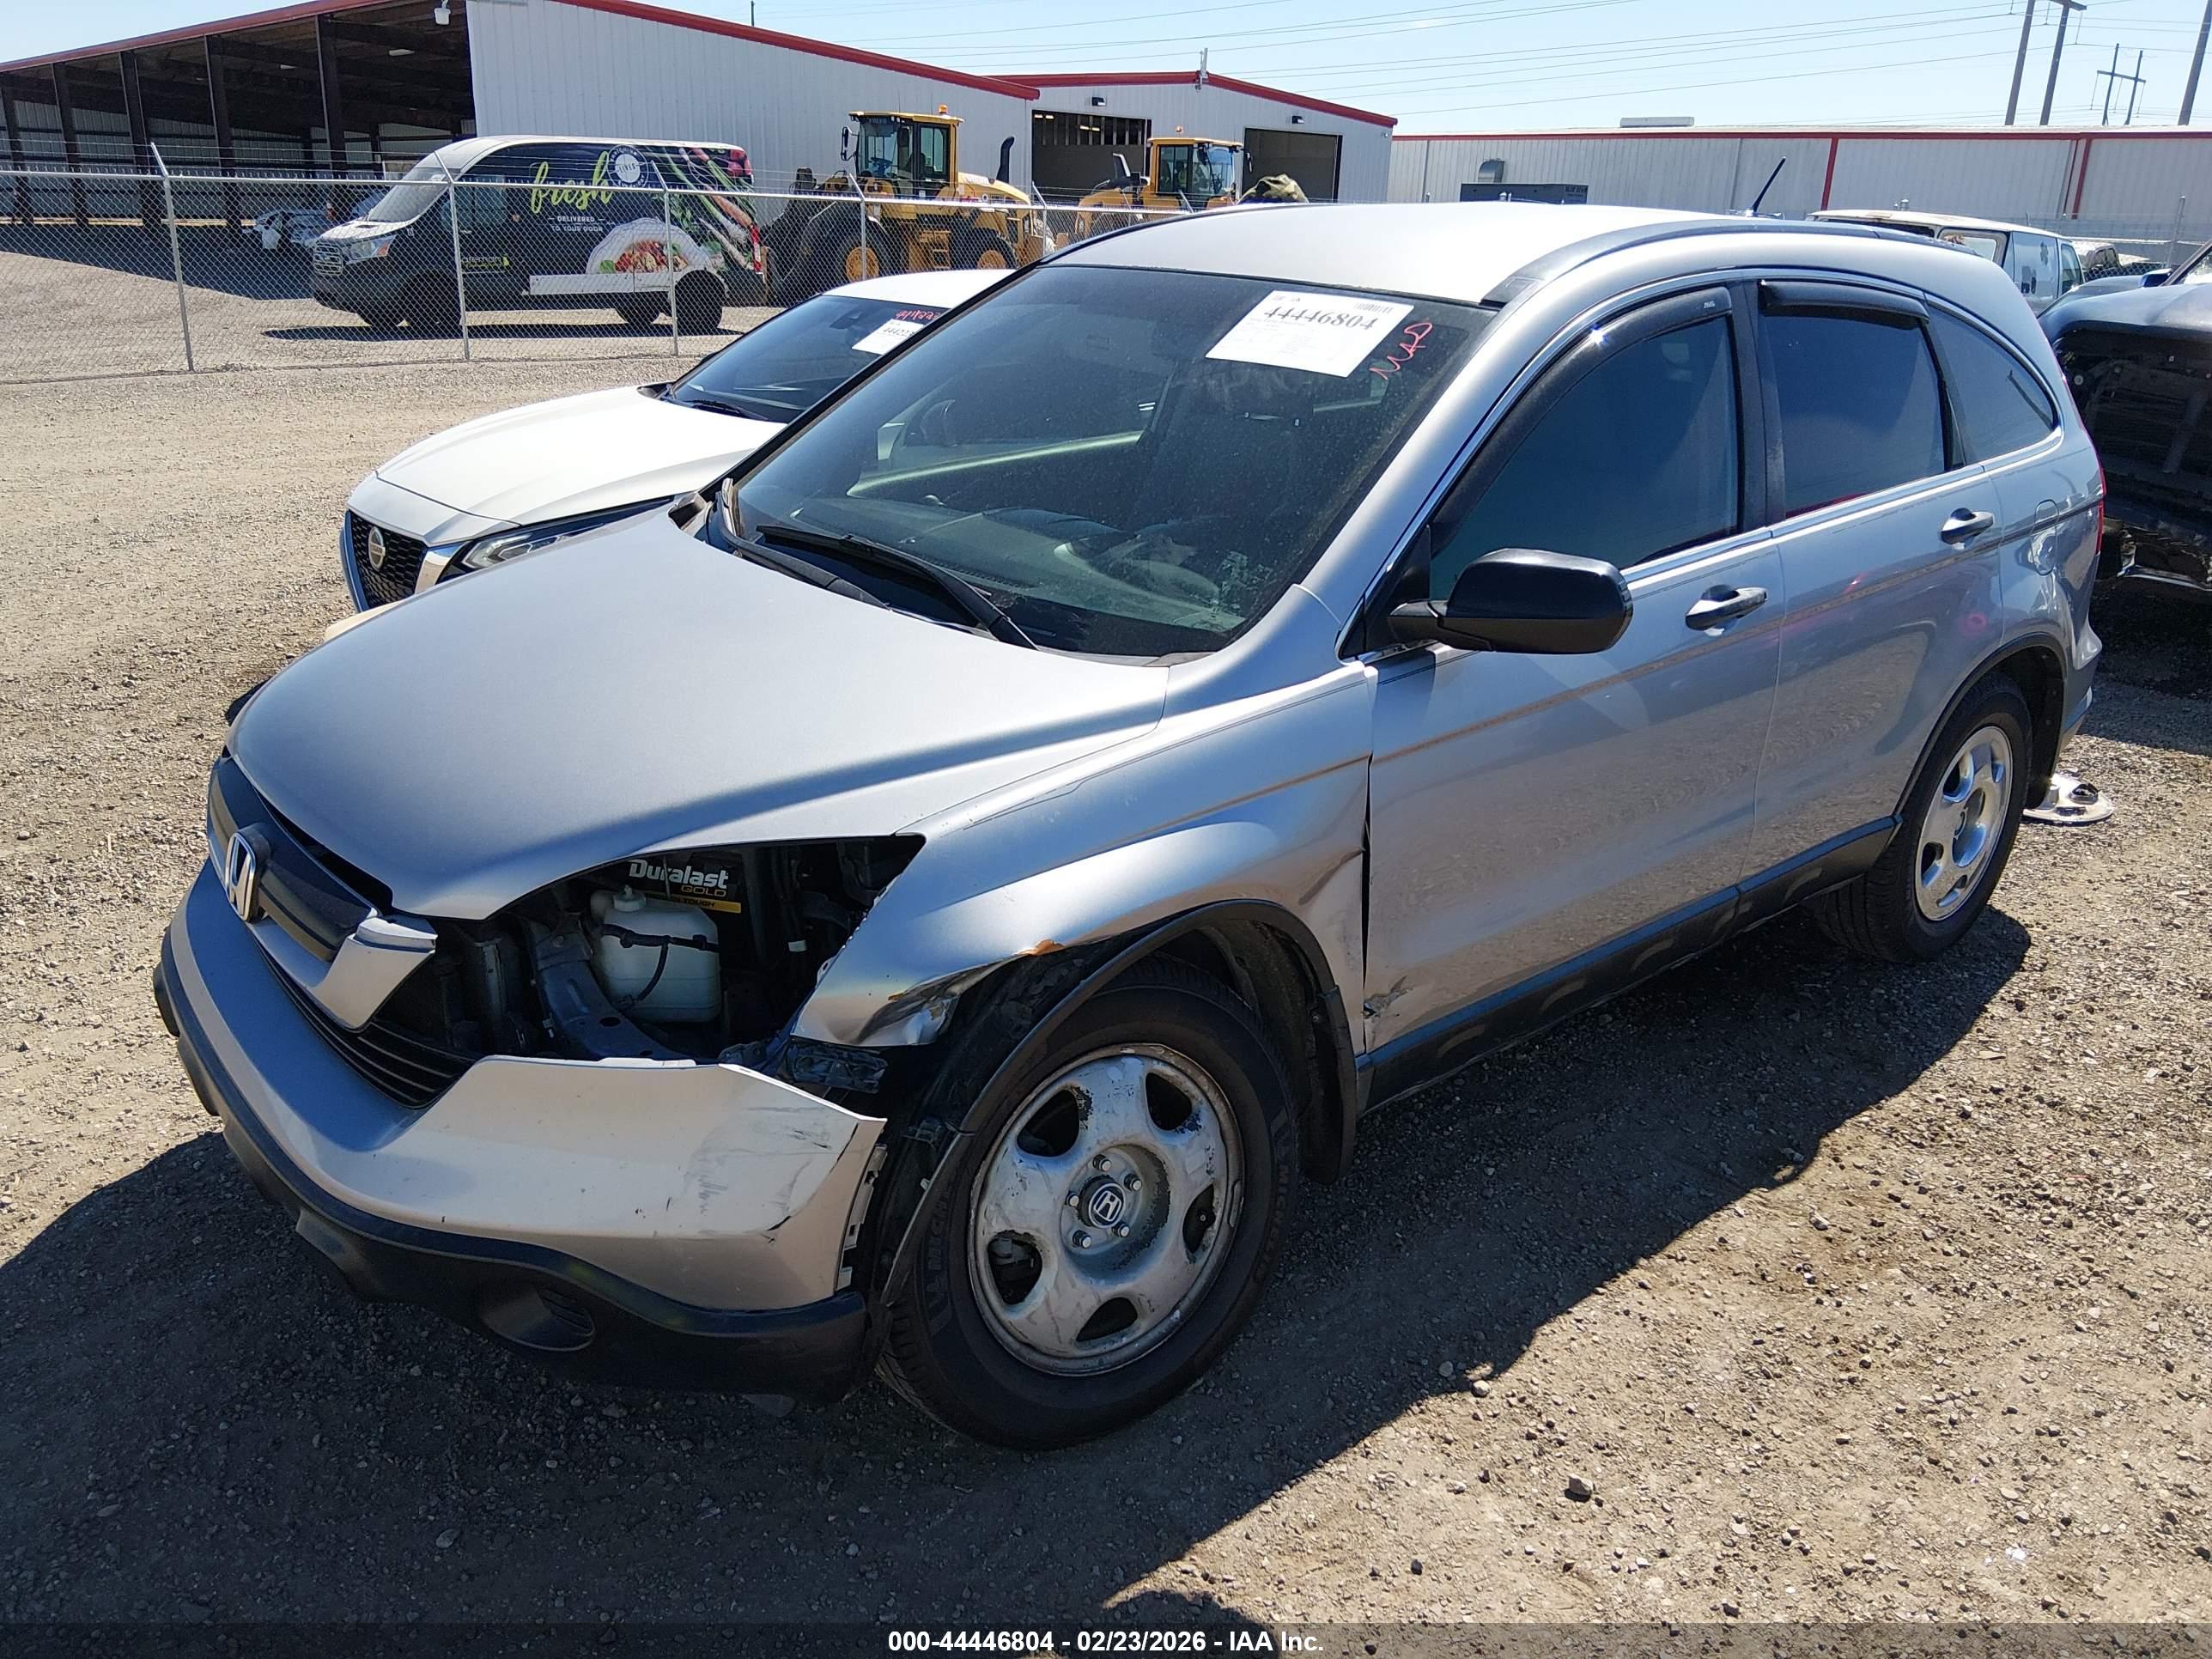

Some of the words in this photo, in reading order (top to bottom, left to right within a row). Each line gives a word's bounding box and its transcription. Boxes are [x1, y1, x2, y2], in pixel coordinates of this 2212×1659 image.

[617, 161, 637, 173] LIVES
[531, 151, 613, 214] fresh
[1263, 306, 1379, 331] 44446804
[629, 859, 729, 890] Duralast
[680, 885, 727, 897] GOLD
